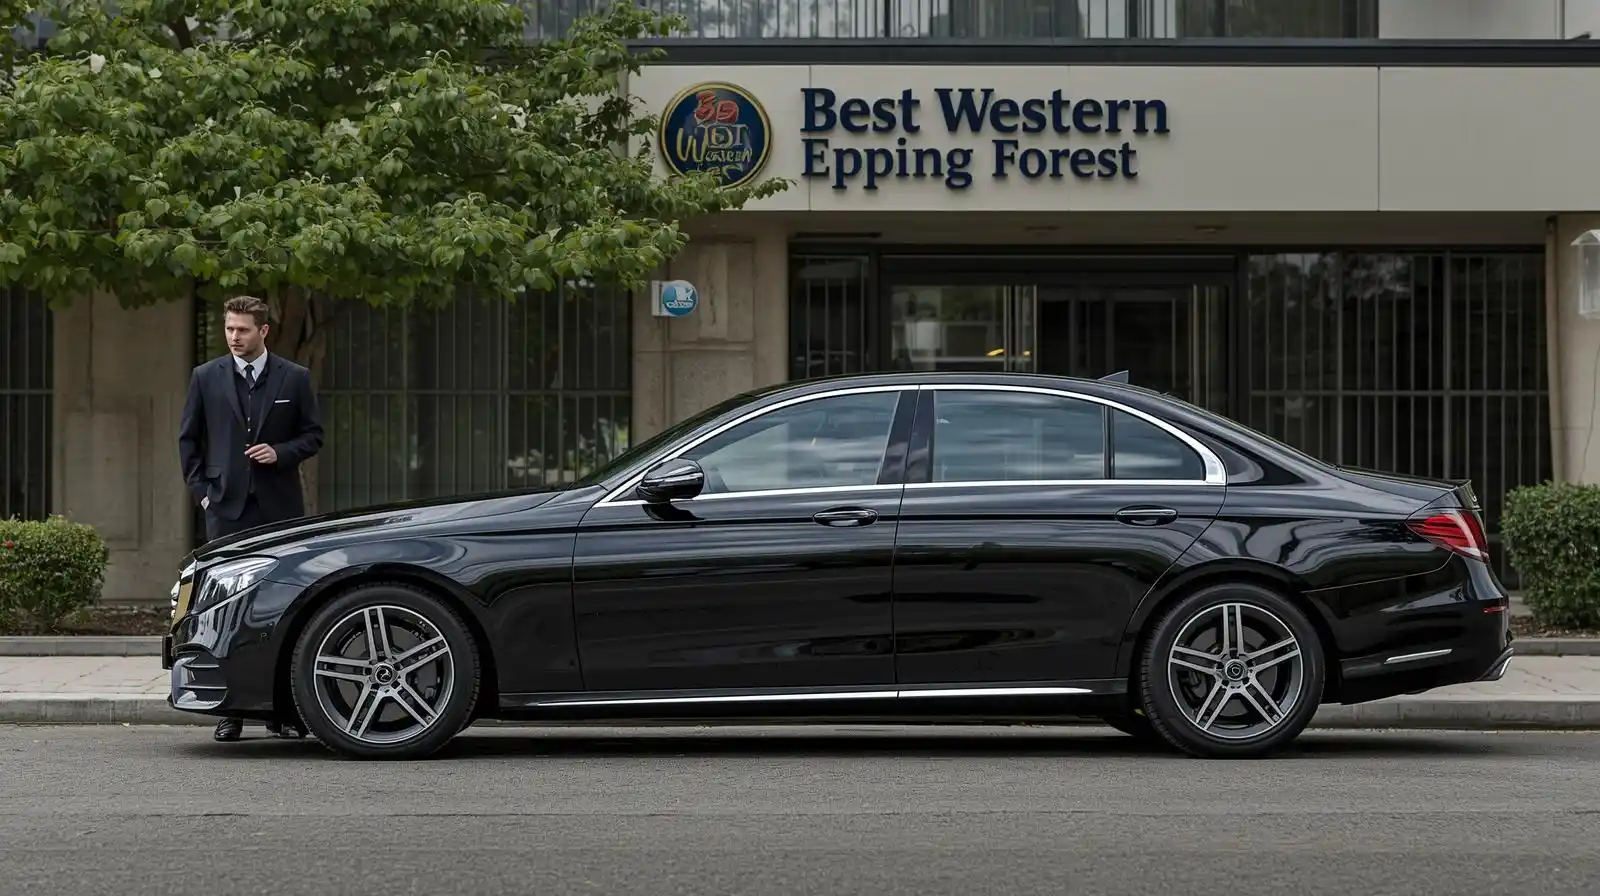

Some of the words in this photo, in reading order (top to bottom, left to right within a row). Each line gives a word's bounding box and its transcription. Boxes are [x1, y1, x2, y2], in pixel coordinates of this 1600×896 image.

[800, 88, 920, 133] Best
[934, 88, 1170, 133] Western
[801, 138, 974, 189] Epping
[992, 139, 1138, 178] Forest
